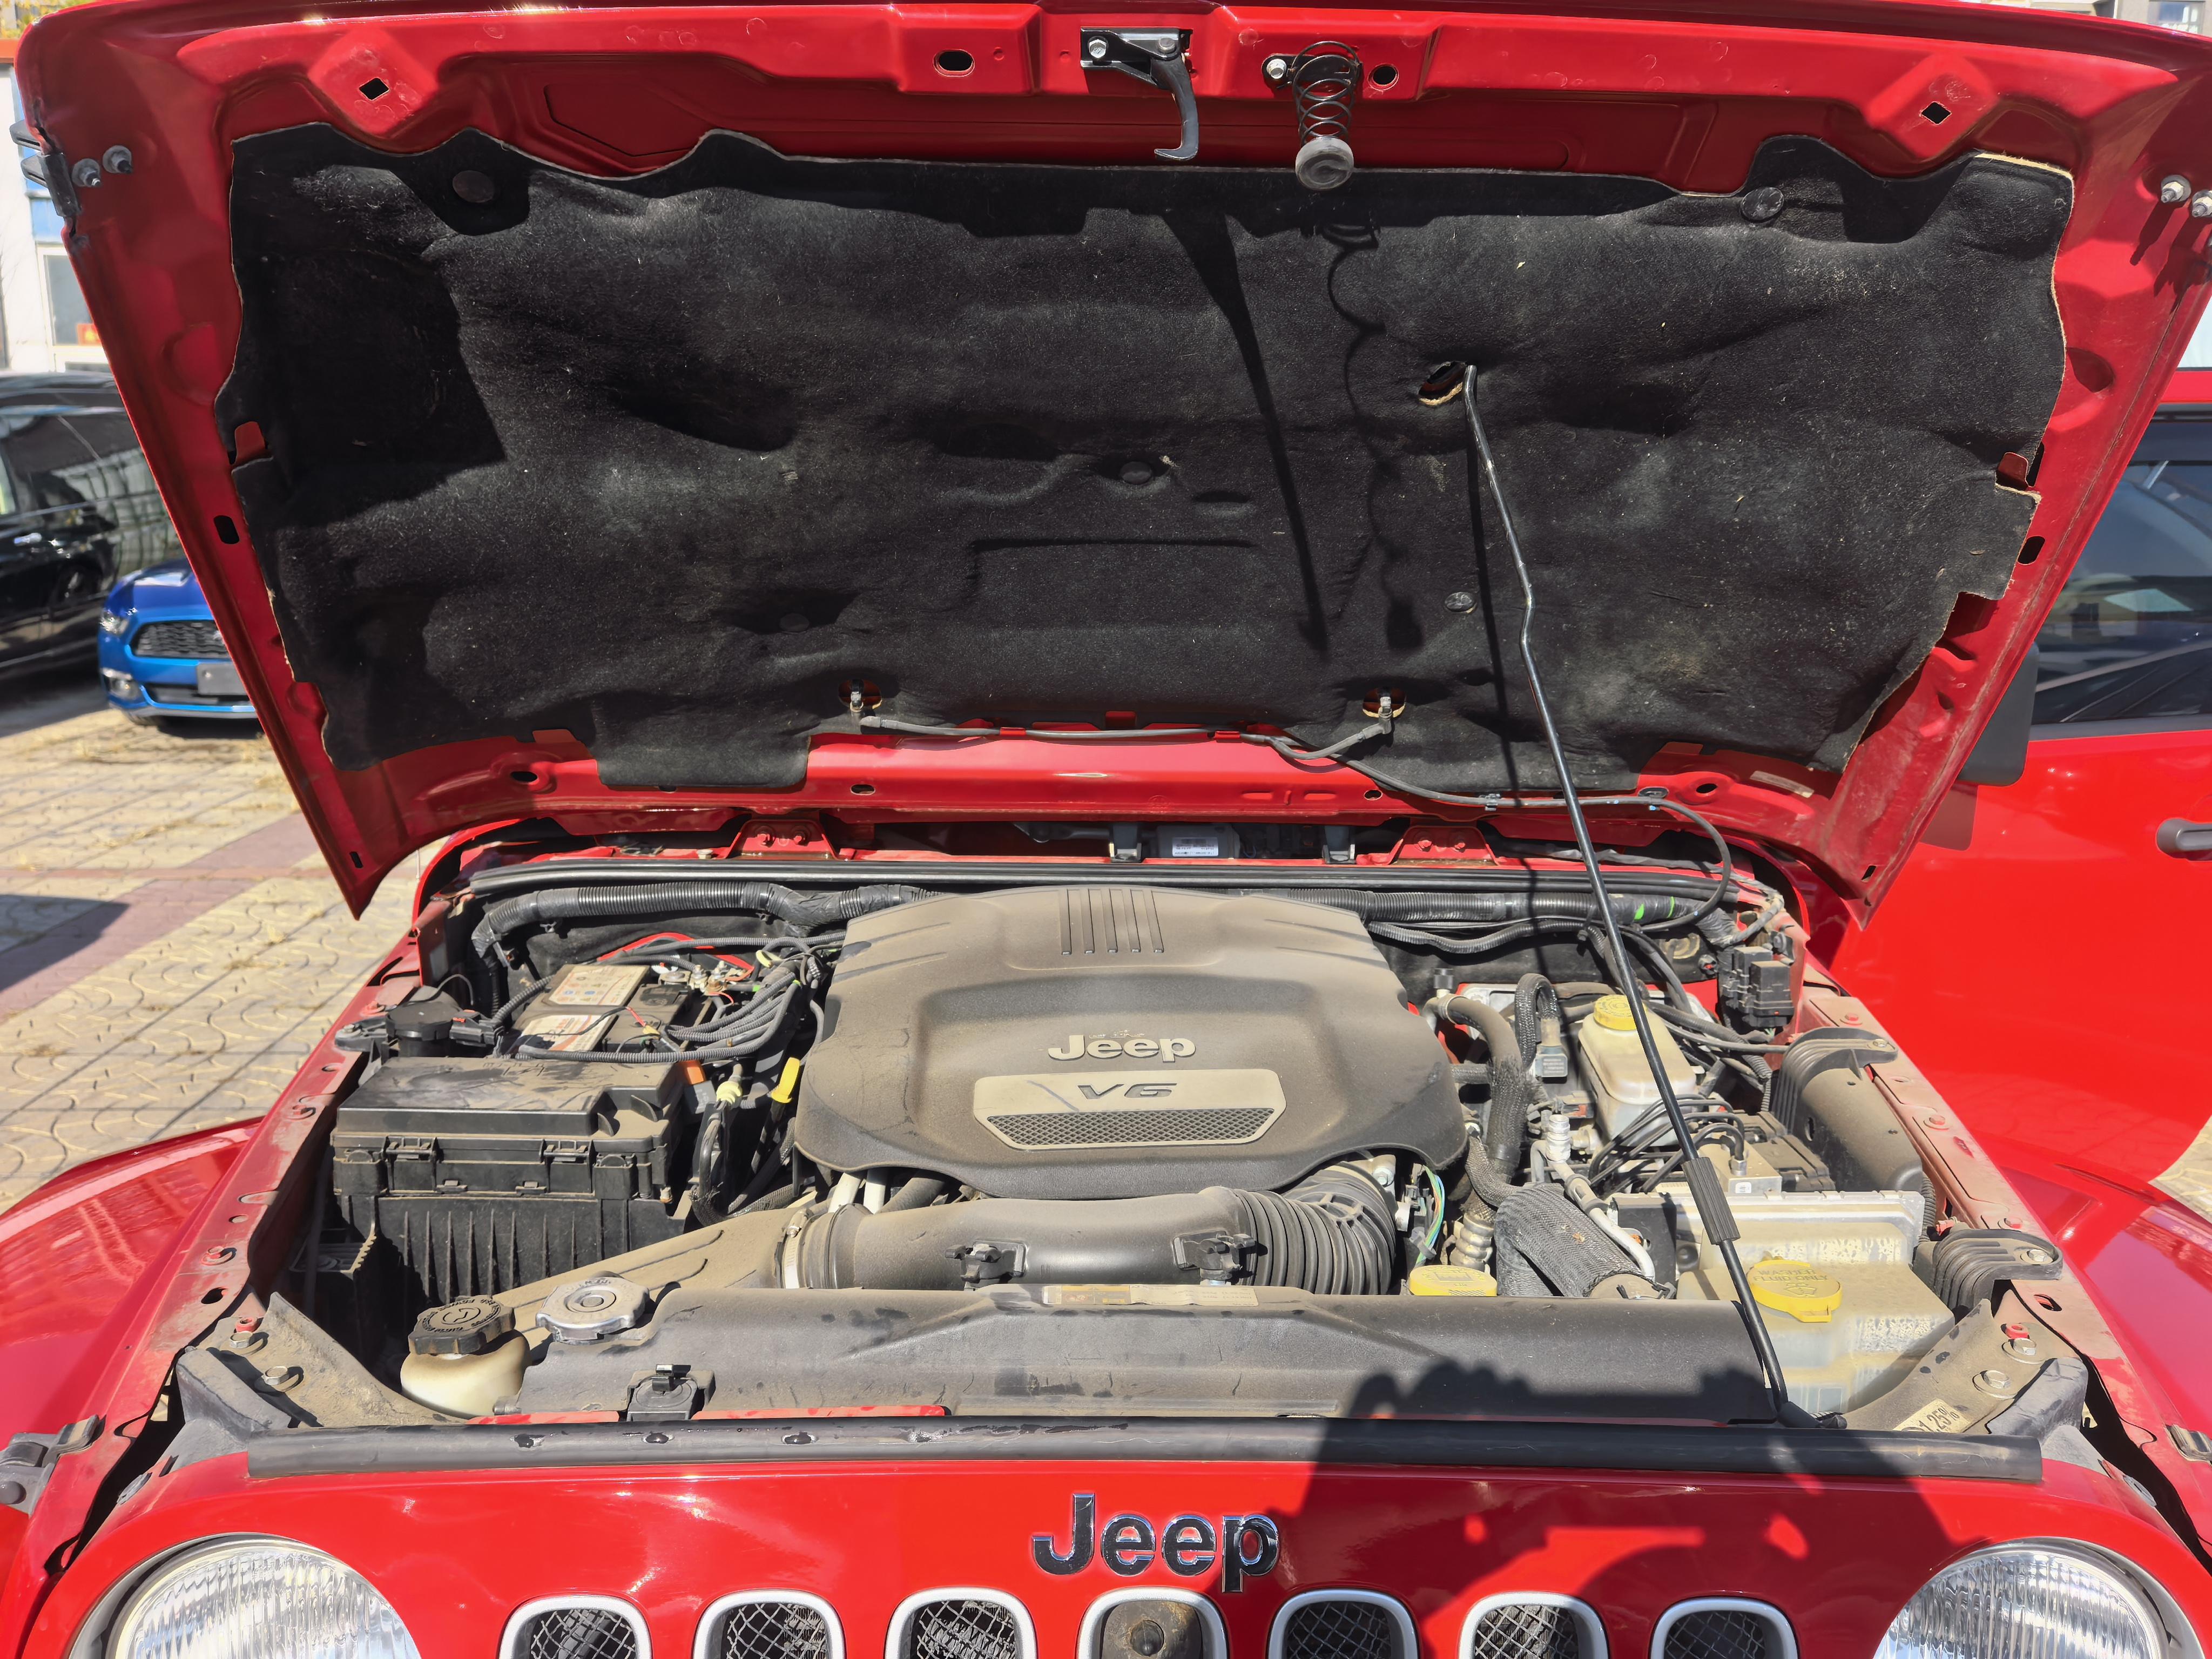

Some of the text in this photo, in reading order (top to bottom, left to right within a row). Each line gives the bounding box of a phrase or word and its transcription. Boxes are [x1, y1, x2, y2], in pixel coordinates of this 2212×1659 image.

[1048, 1035, 1196, 1063] Jeep
[1077, 1083, 1177, 1100] V6
[1031, 1492, 1280, 1593] Jeep
